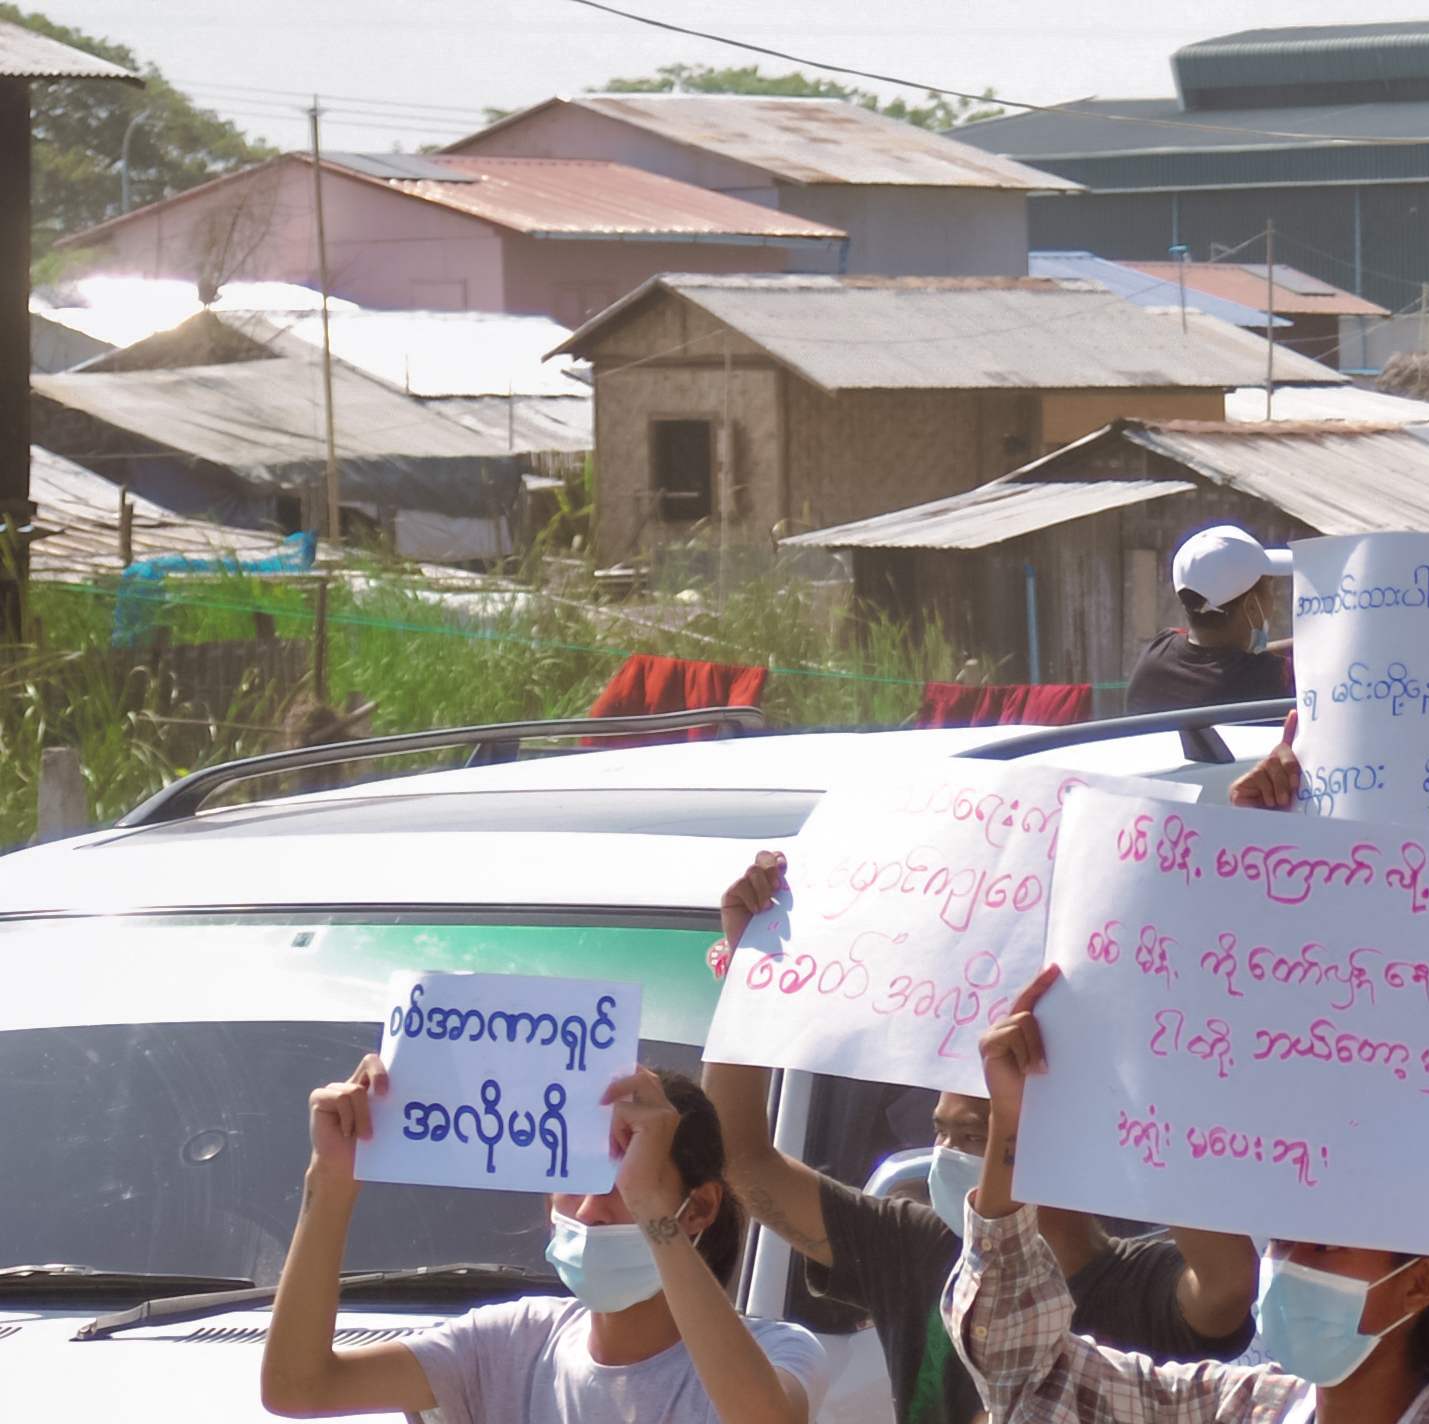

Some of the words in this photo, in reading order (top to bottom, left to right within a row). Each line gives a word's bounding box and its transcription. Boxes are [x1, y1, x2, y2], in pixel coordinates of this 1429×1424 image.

[389, 983, 617, 1072] စစ်အာဏာရှင်
[402, 1079, 570, 1178] အလိုမရှိ
